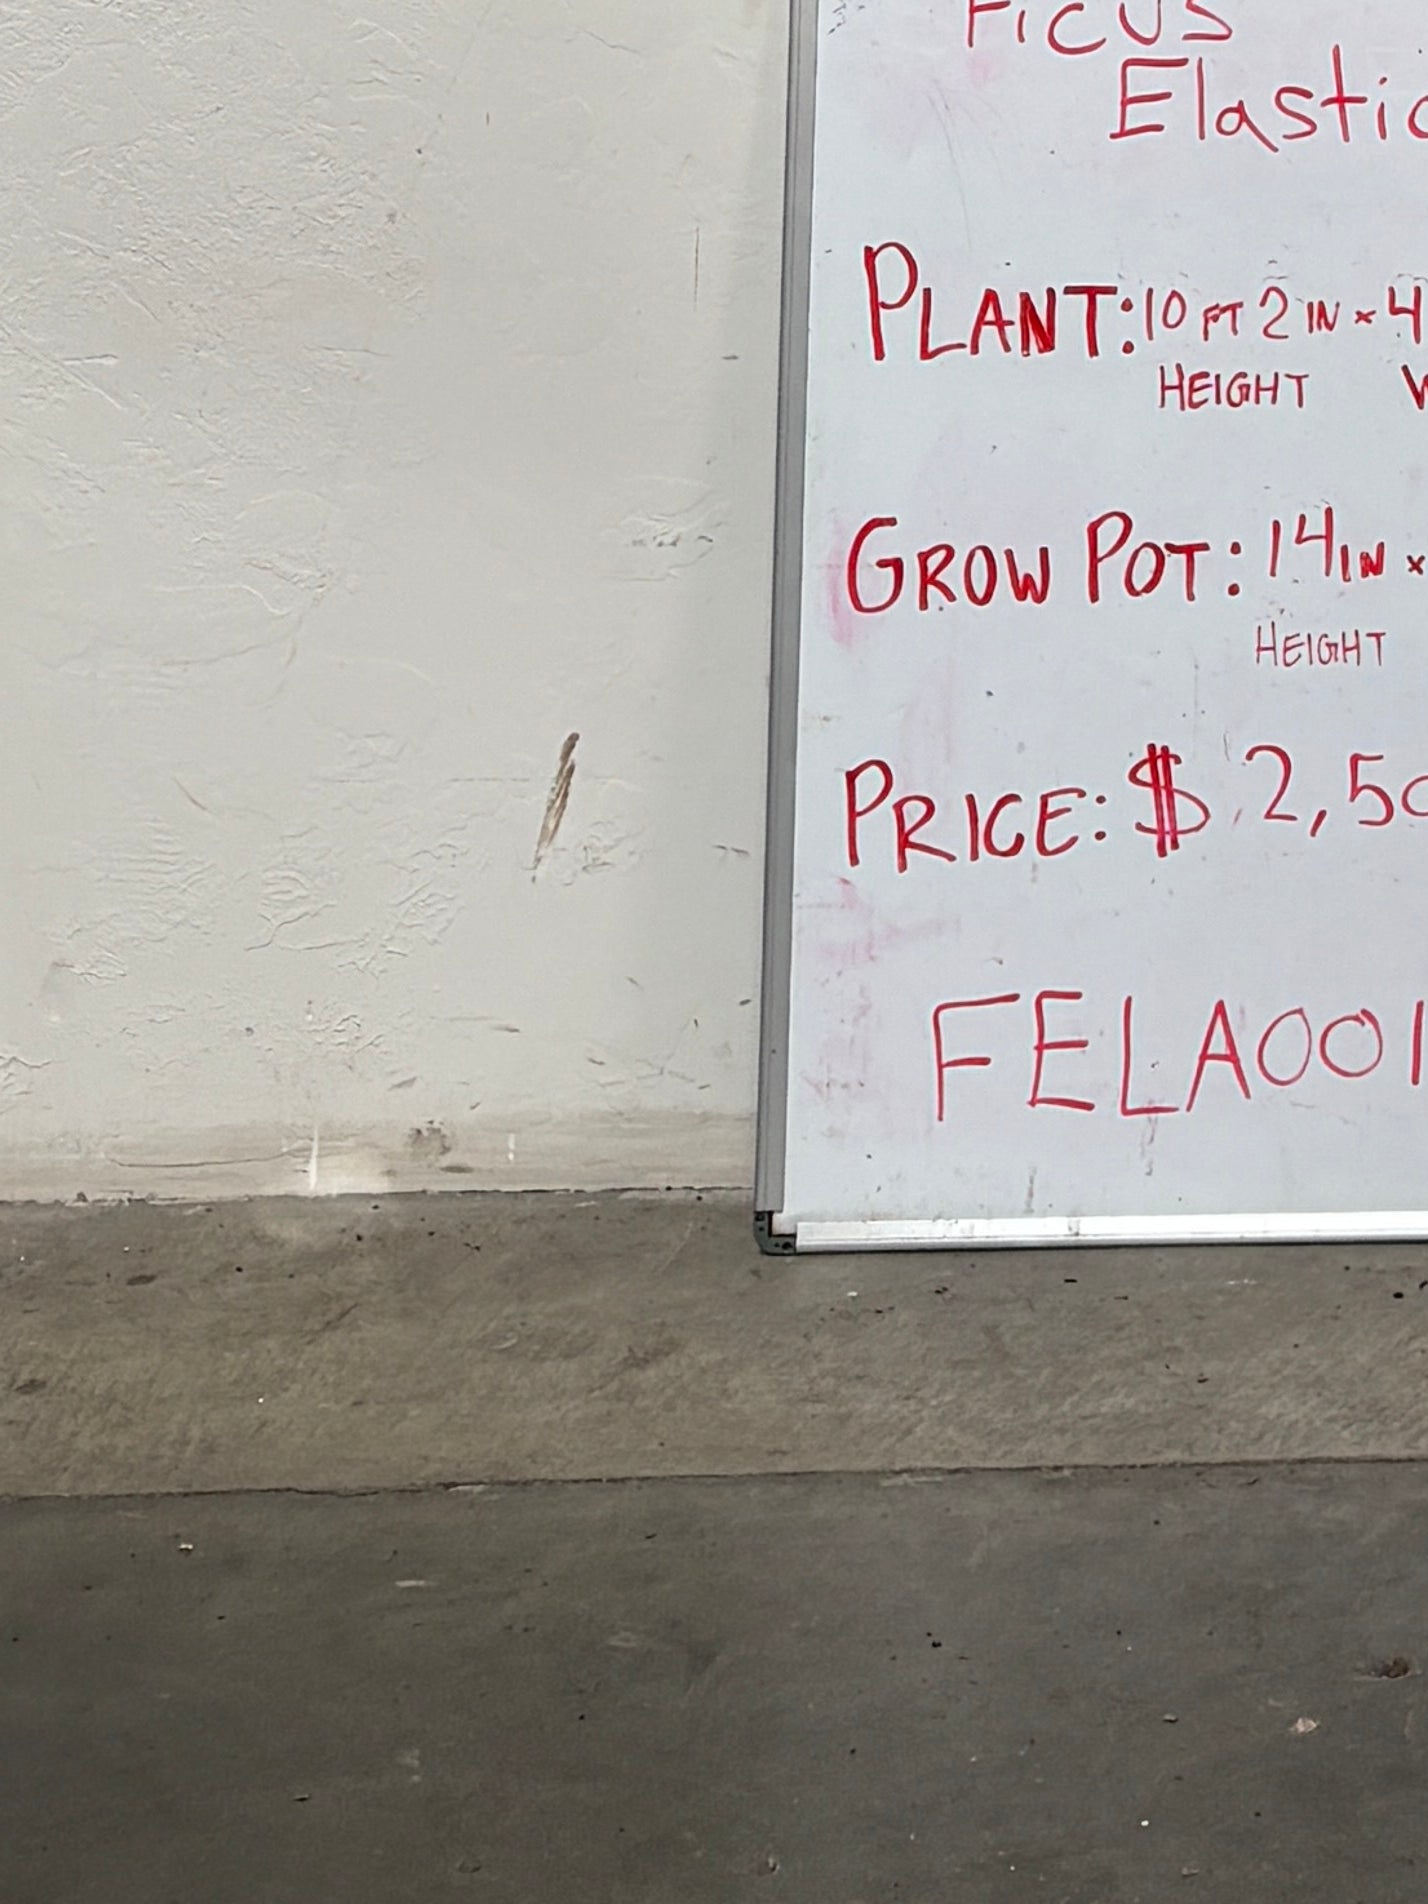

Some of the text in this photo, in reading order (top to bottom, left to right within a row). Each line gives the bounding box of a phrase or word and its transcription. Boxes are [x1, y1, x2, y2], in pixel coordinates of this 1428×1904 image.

[861, 241, 1135, 363] PLANT:
[1144, 289, 1188, 340] 10
[1200, 300, 1244, 342] FT
[1258, 285, 1289, 341] 2
[1304, 300, 1339, 333] IN
[1386, 285, 1423, 344] 4
[1158, 365, 1305, 411] HEIGHT
[843, 515, 1052, 616] GROW
[1084, 510, 1242, 605] POT:
[1255, 620, 1387, 667] HEIGHT
[843, 759, 1105, 875] PRICE:
[1126, 742, 1211, 860] $
[930, 988, 1425, 1122] FELA001
